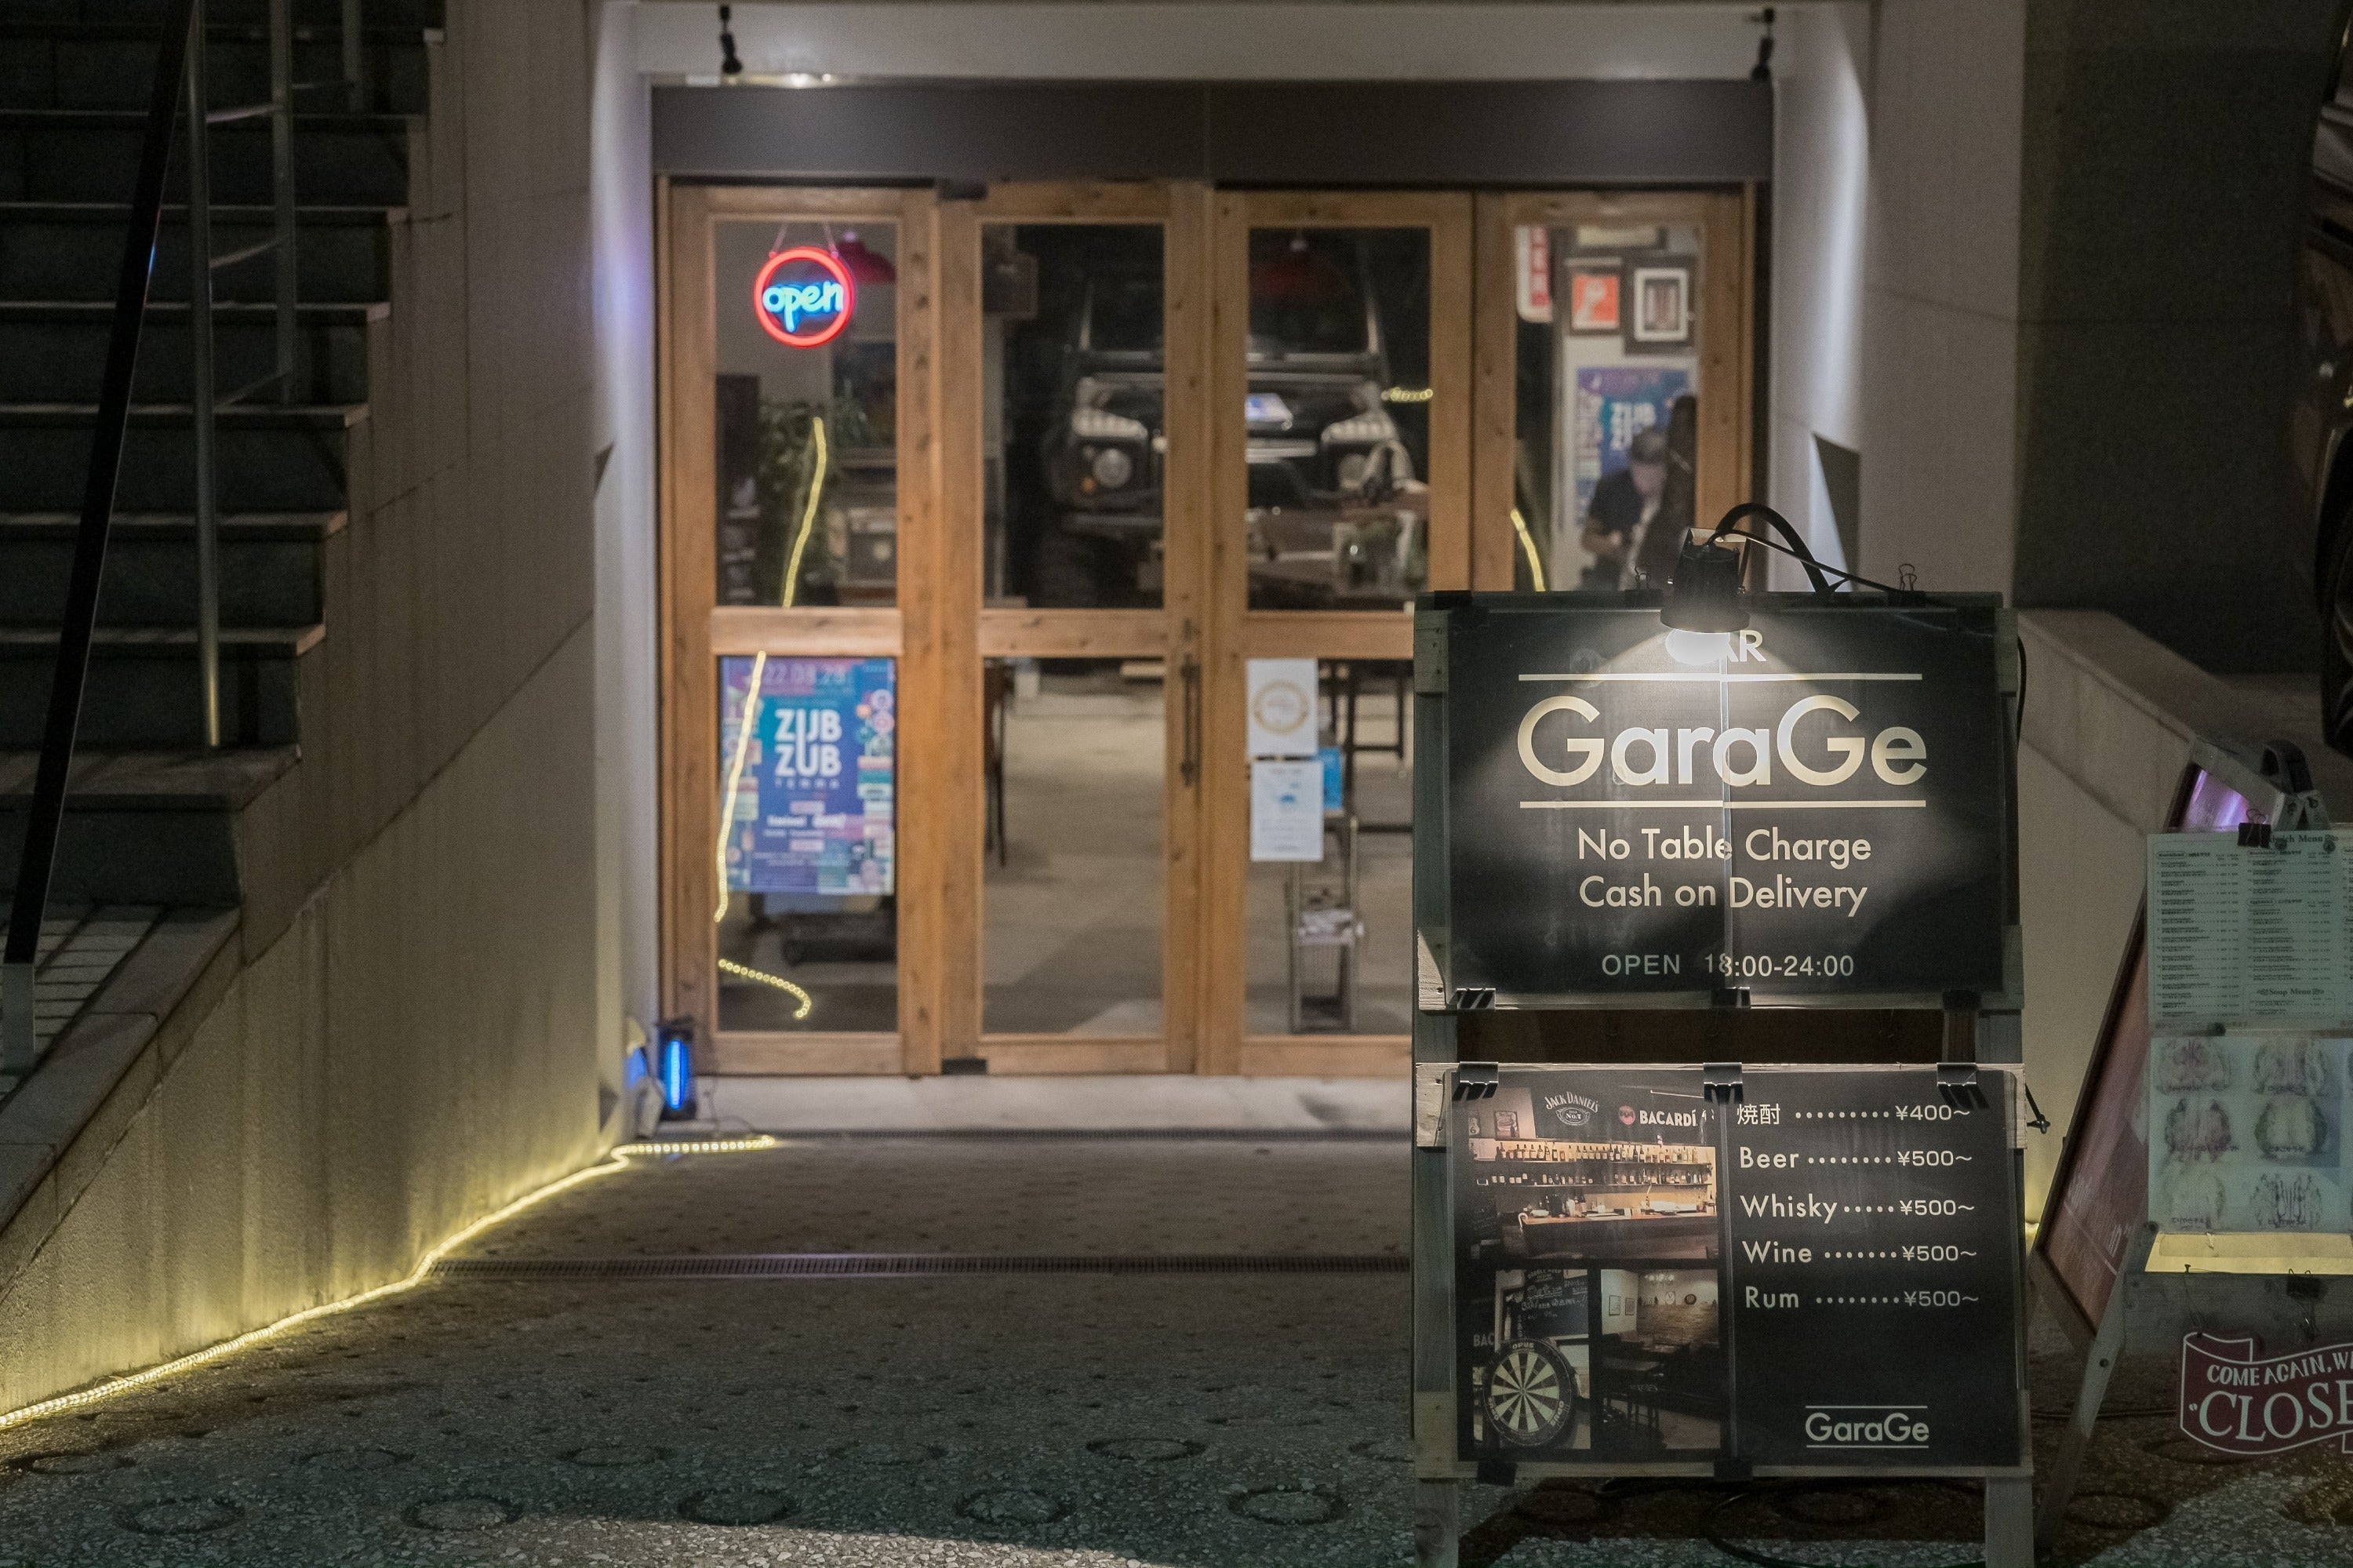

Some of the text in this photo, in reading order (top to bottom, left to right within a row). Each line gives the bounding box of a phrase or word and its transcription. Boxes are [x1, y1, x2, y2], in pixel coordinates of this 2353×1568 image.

[762, 281, 844, 333] open
[774, 708, 842, 742] ZUB
[1517, 695, 1927, 787] GaraGe
[774, 744, 842, 777] ZUB
[1578, 824, 1871, 870] No Table Charge
[1580, 874, 1868, 917] Cash on Delivery
[1602, 952, 1855, 977] OPEN 18:00-24:00
[2268, 988, 2288, 997] Soup
[1544, 1094, 1566, 1110] JACK
[1737, 1103, 1781, 1125] 焼酎
[1740, 1146, 1799, 1169] Beer
[1740, 1194, 1838, 1224] Whisky
[1741, 1240, 1812, 1264] Wine
[1745, 1286, 1799, 1309] Rum
[2206, 1363, 2260, 1387] COME
[1805, 1413, 1929, 1442] GaraGe
